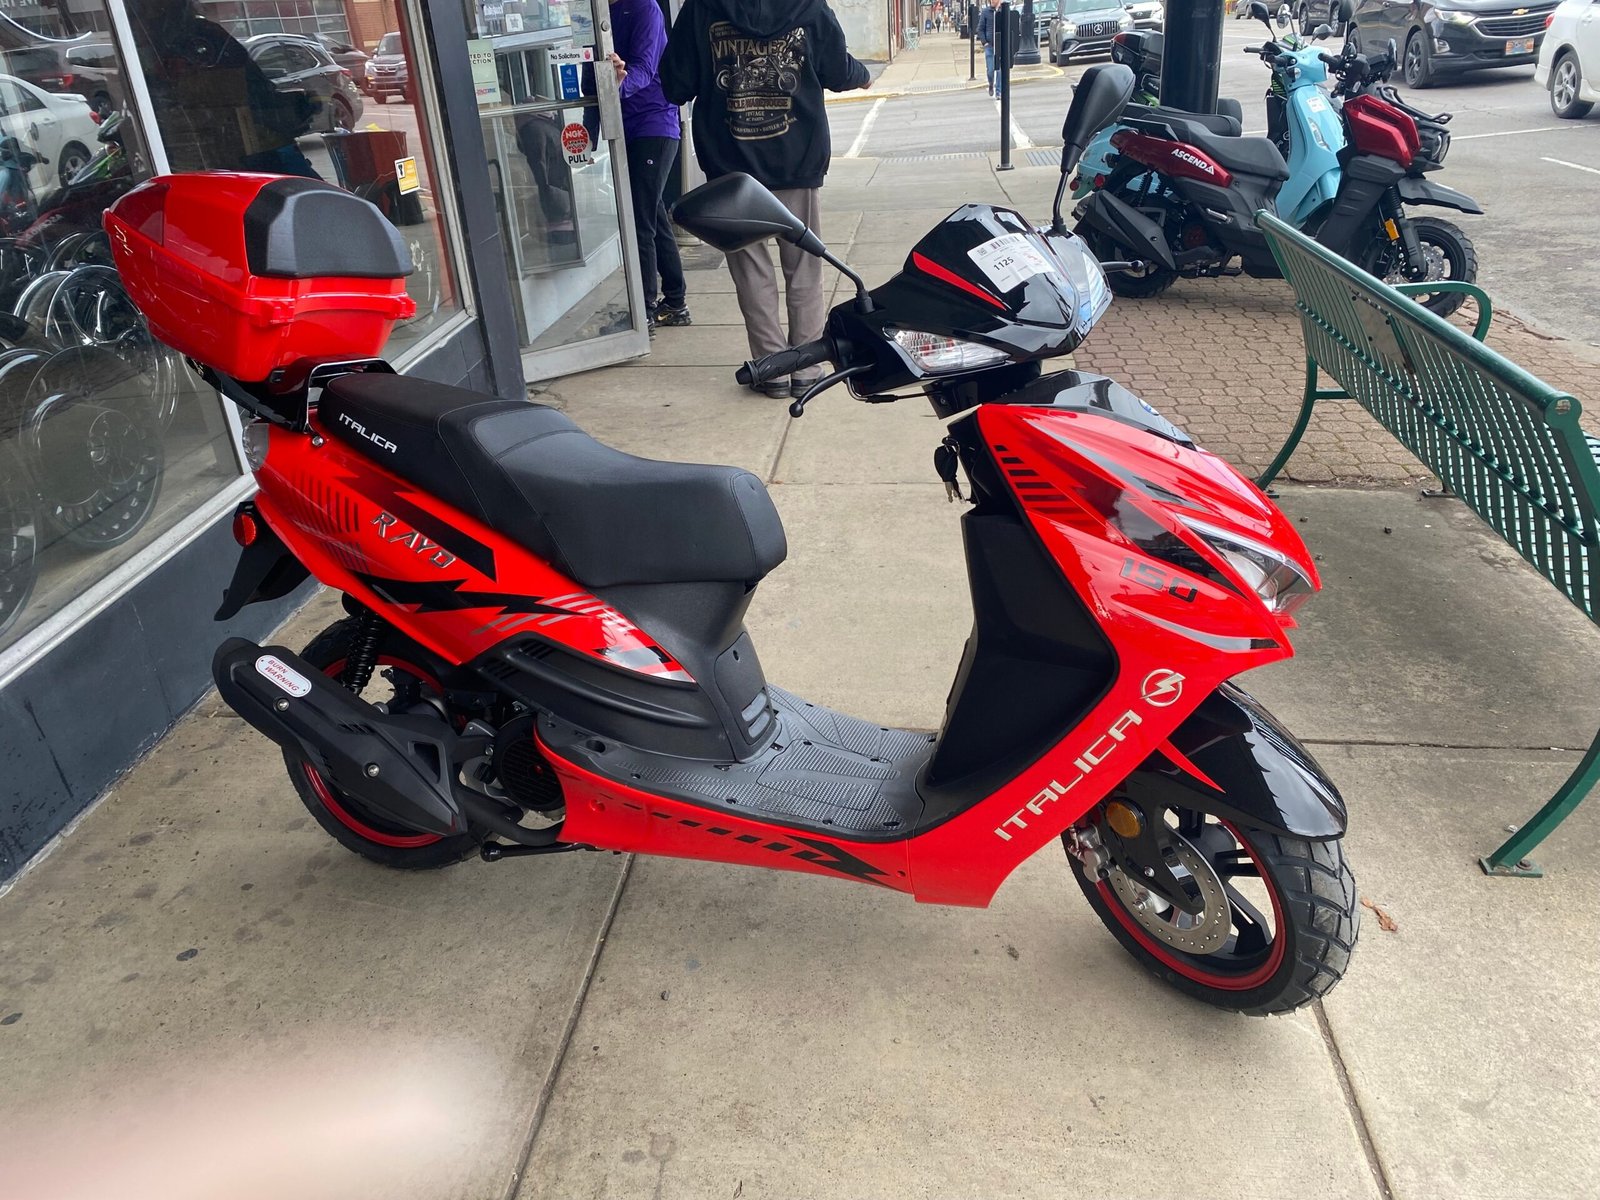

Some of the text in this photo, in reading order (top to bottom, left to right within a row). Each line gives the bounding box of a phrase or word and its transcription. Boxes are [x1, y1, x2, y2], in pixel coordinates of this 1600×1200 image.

[565, 129, 584, 139] NGK
[568, 154, 588, 164] PULL
[993, 256, 1014, 271] 1125
[338, 413, 398, 454] ITALICA
[370, 509, 457, 569] RAYO
[1119, 557, 1198, 603] 150
[264, 666, 300, 692] WARNING
[267, 659, 289, 674] BURN
[993, 709, 1143, 842] ITALICA
